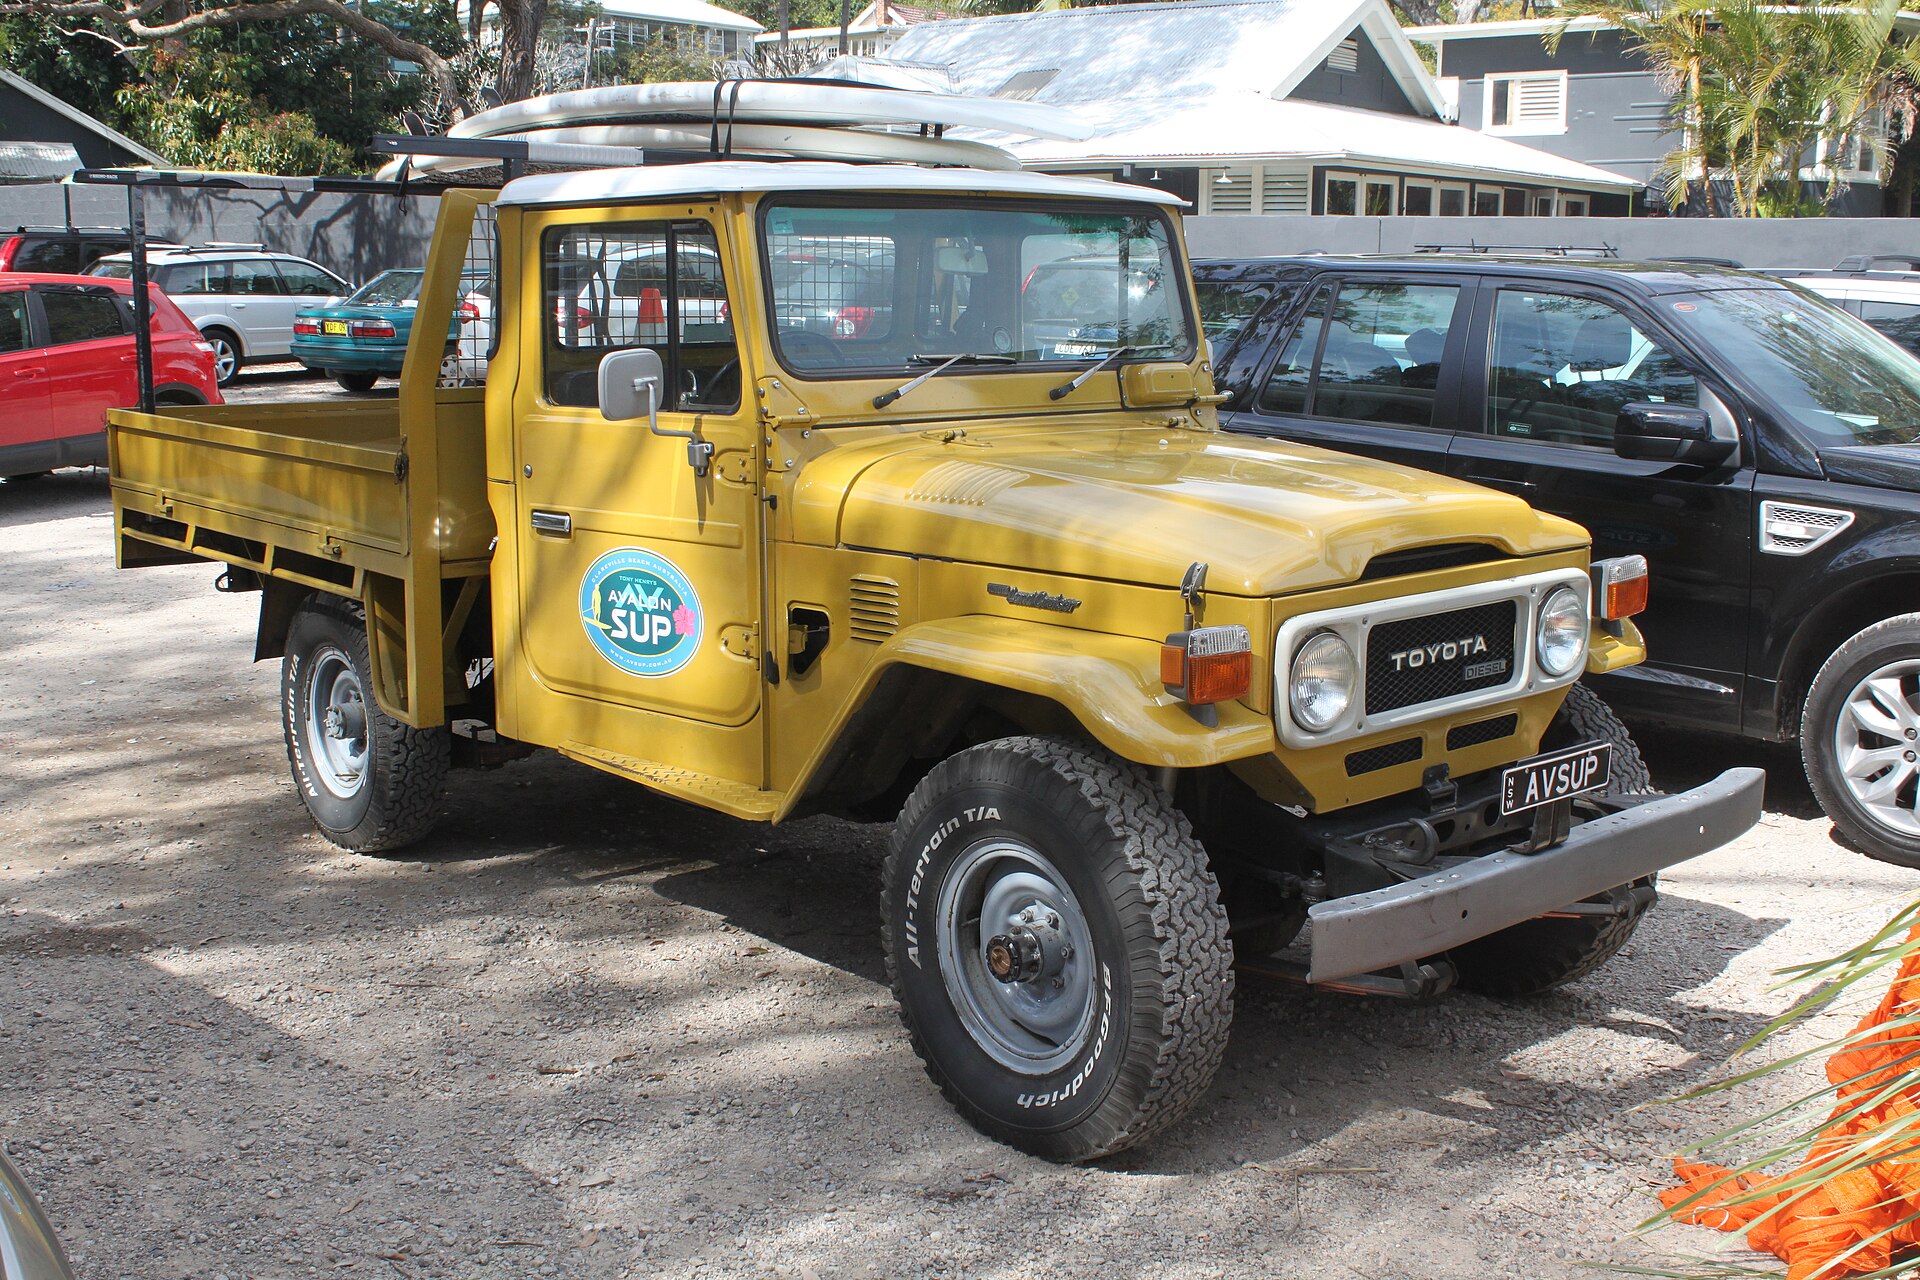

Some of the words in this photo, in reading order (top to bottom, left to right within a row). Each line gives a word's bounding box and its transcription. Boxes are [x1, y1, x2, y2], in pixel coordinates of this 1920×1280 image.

[591, 557, 626, 583] CLAREVILLE
[628, 557, 651, 567] BEACH
[653, 563, 688, 597] AUSTRALIA
[619, 575, 634, 583] TONY
[634, 578, 658, 586] HENRY'S
[607, 589, 672, 612] AVALON
[610, 608, 672, 645] SUP
[1390, 635, 1488, 671] TOYOTA
[1466, 661, 1506, 679] DIESEL
[287, 687, 318, 797] All-Terrain
[1525, 755, 1598, 803] AVSUP
[905, 816, 961, 970] All-Terrain
[963, 806, 1002, 821] T/A
[1016, 961, 1112, 1109] BFGoodrich
